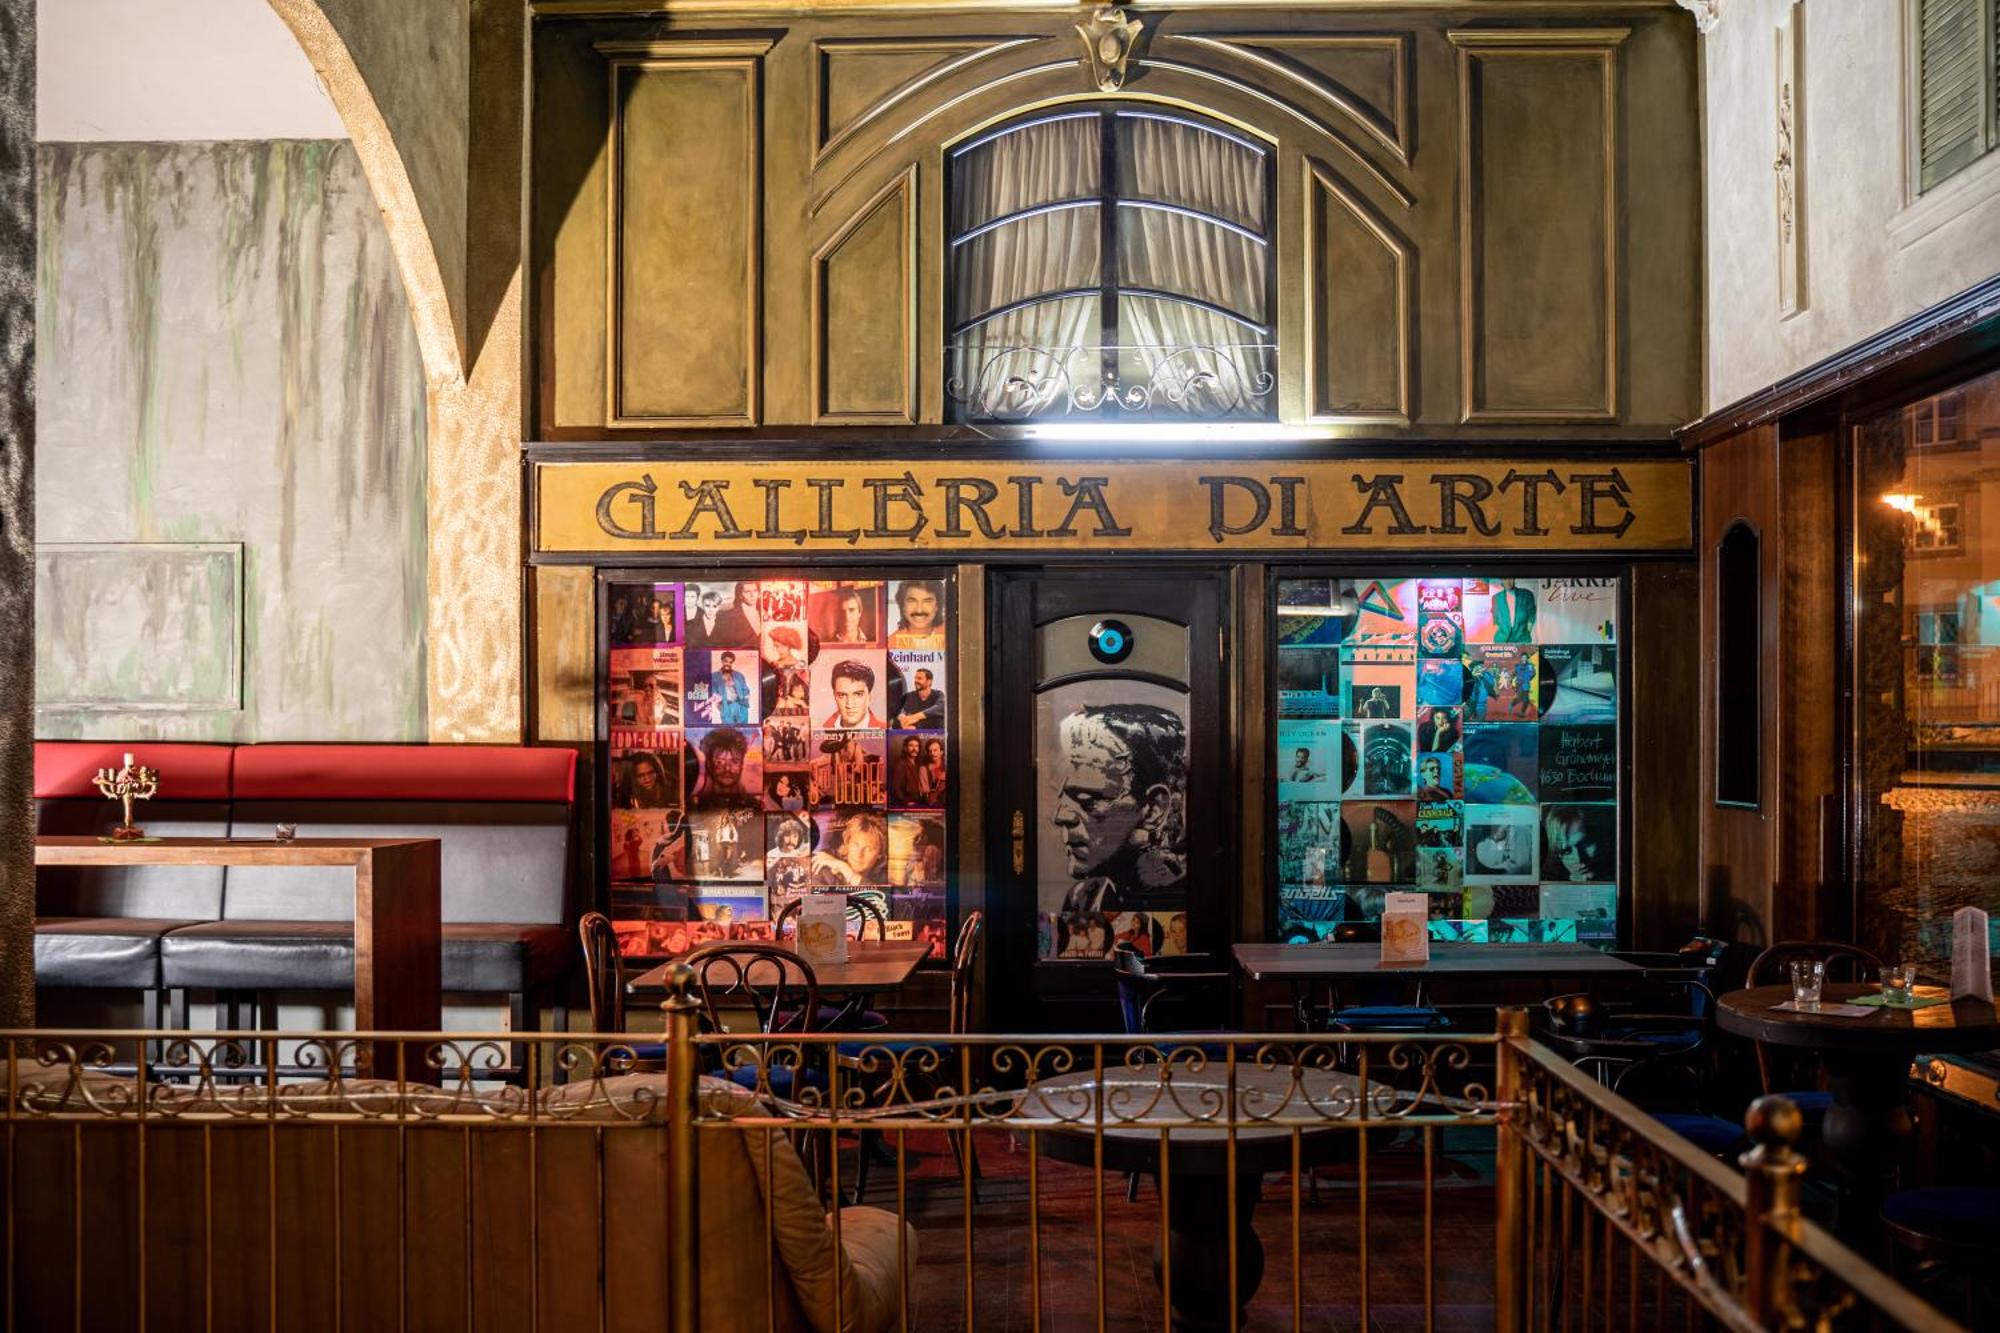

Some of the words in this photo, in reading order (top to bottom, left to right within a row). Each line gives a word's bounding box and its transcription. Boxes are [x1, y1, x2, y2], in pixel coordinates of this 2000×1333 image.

[597, 470, 1132, 546] GALLERIA
[1199, 475, 1308, 544] DI
[1342, 467, 1637, 540] ARTE
